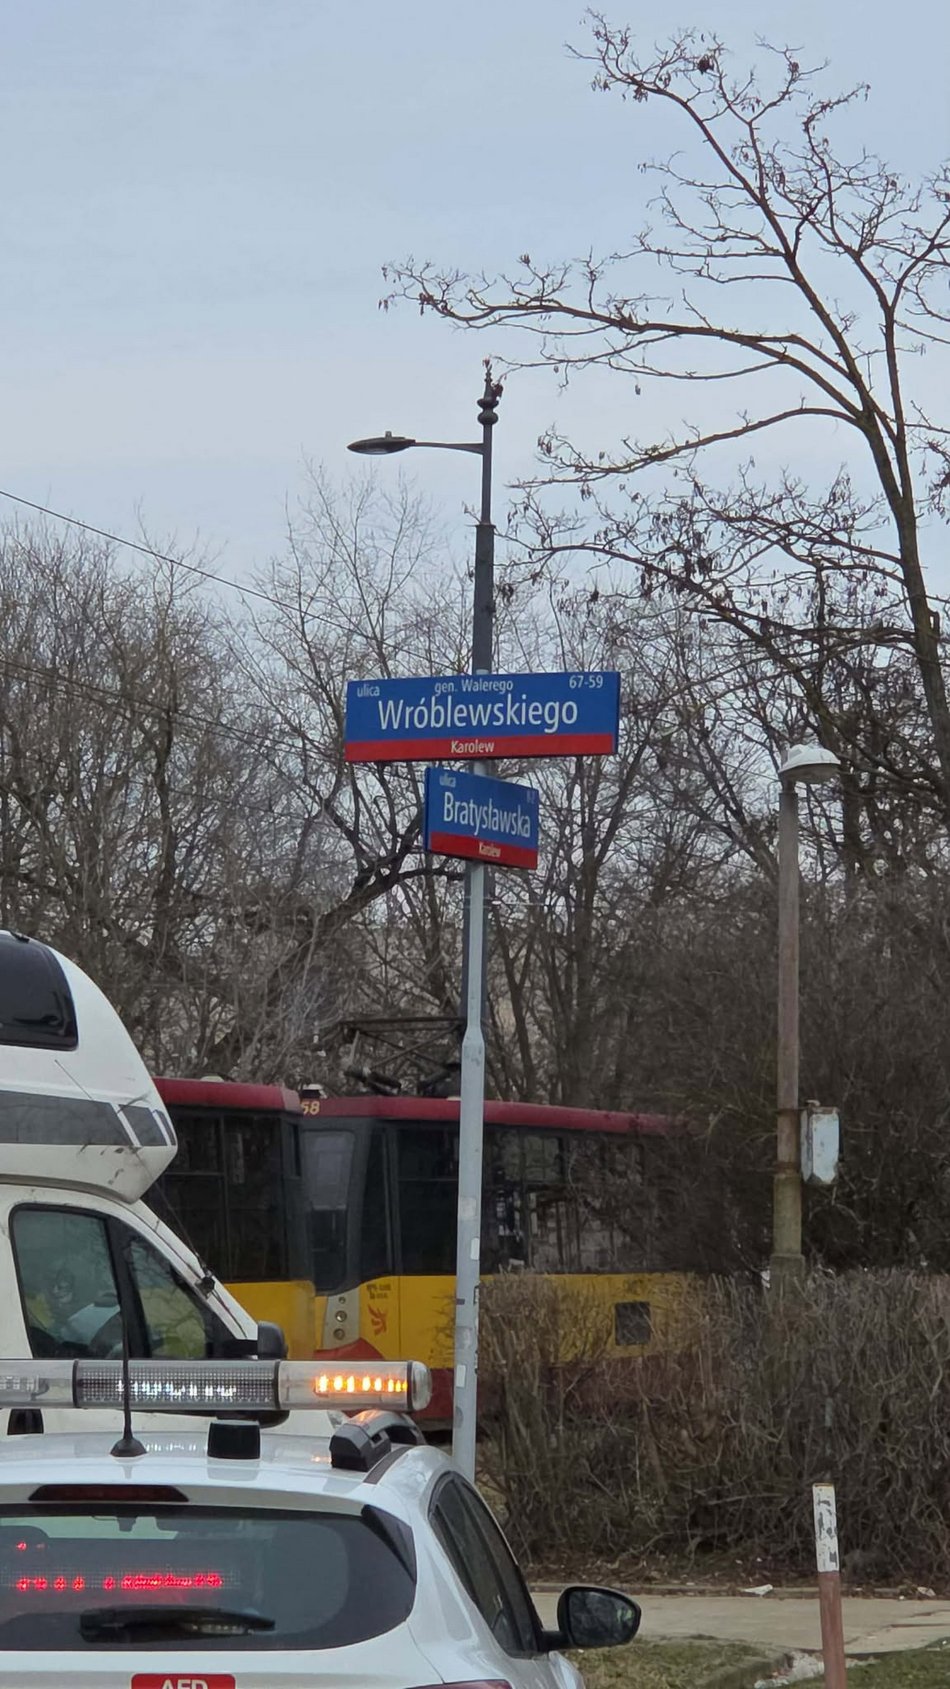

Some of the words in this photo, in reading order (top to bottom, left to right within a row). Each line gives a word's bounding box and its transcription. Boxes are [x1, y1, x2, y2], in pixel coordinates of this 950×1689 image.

[434, 681, 457, 696] gen.
[461, 678, 514, 693] Walerego
[569, 675, 604, 690] 67-59
[357, 685, 380, 698] ulica
[377, 693, 579, 734] Wróblewskiego
[450, 739, 495, 754] Karolew
[443, 791, 531, 838] Bratysławska
